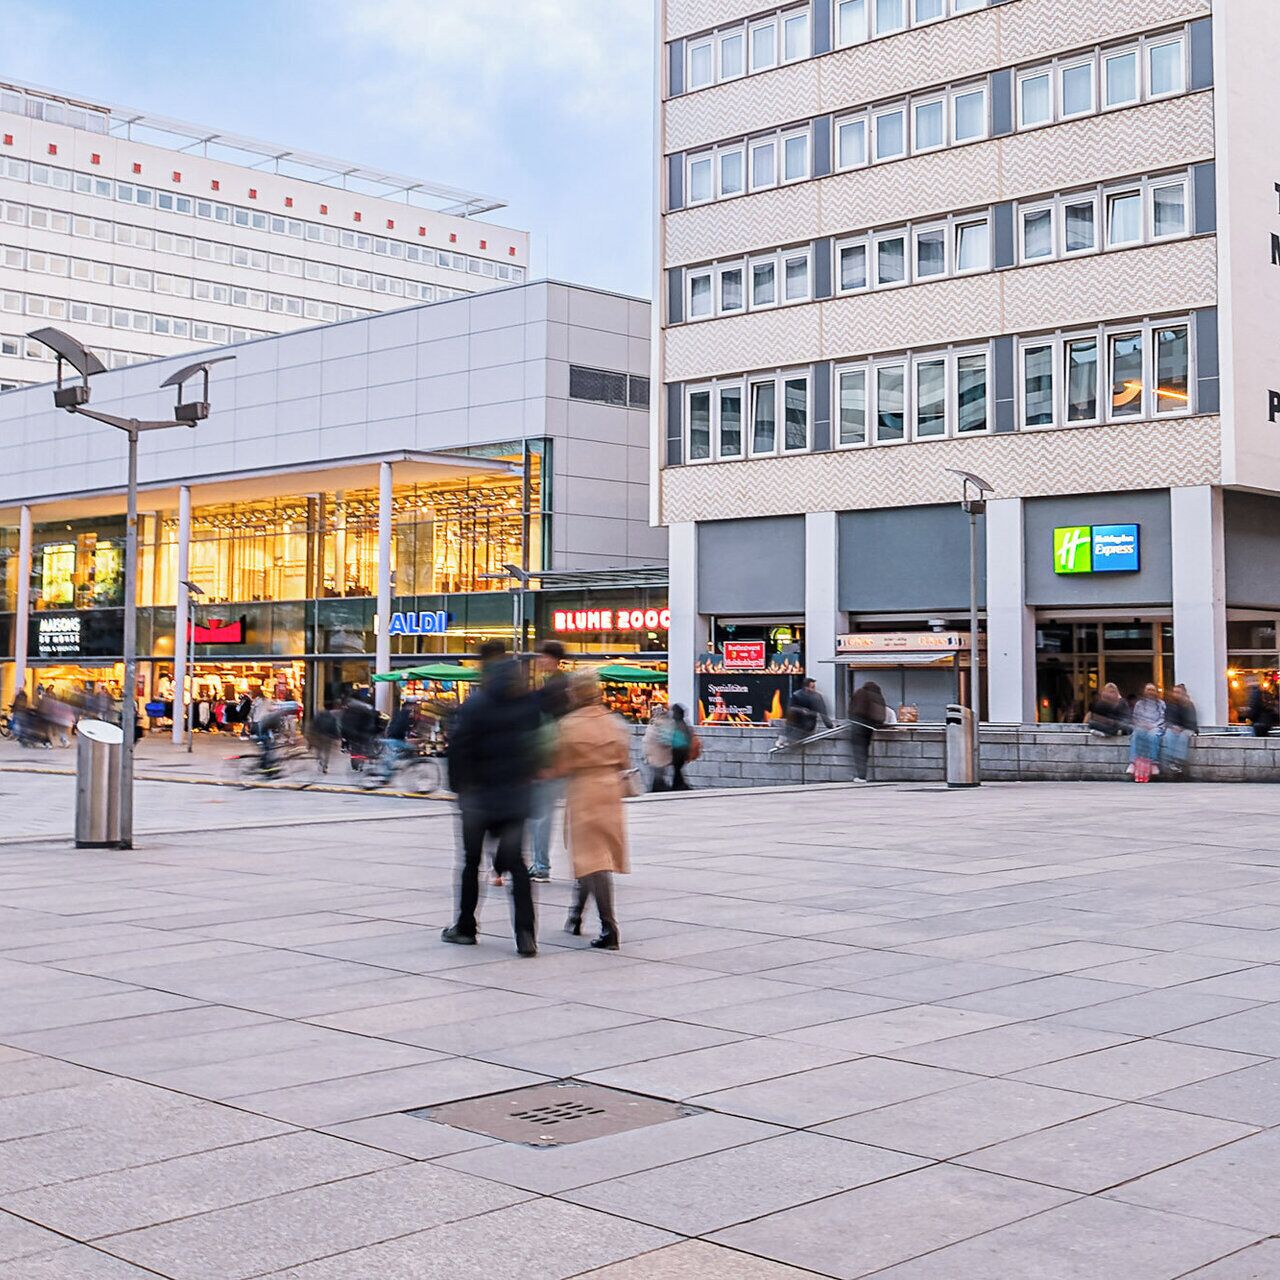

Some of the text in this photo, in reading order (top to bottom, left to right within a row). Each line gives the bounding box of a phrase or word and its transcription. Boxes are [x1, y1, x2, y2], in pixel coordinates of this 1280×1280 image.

[1094, 544, 1135, 557] Express
[39, 616, 81, 632] MAISONS
[388, 611, 448, 635] ALDI
[554, 610, 612, 630] BLUME
